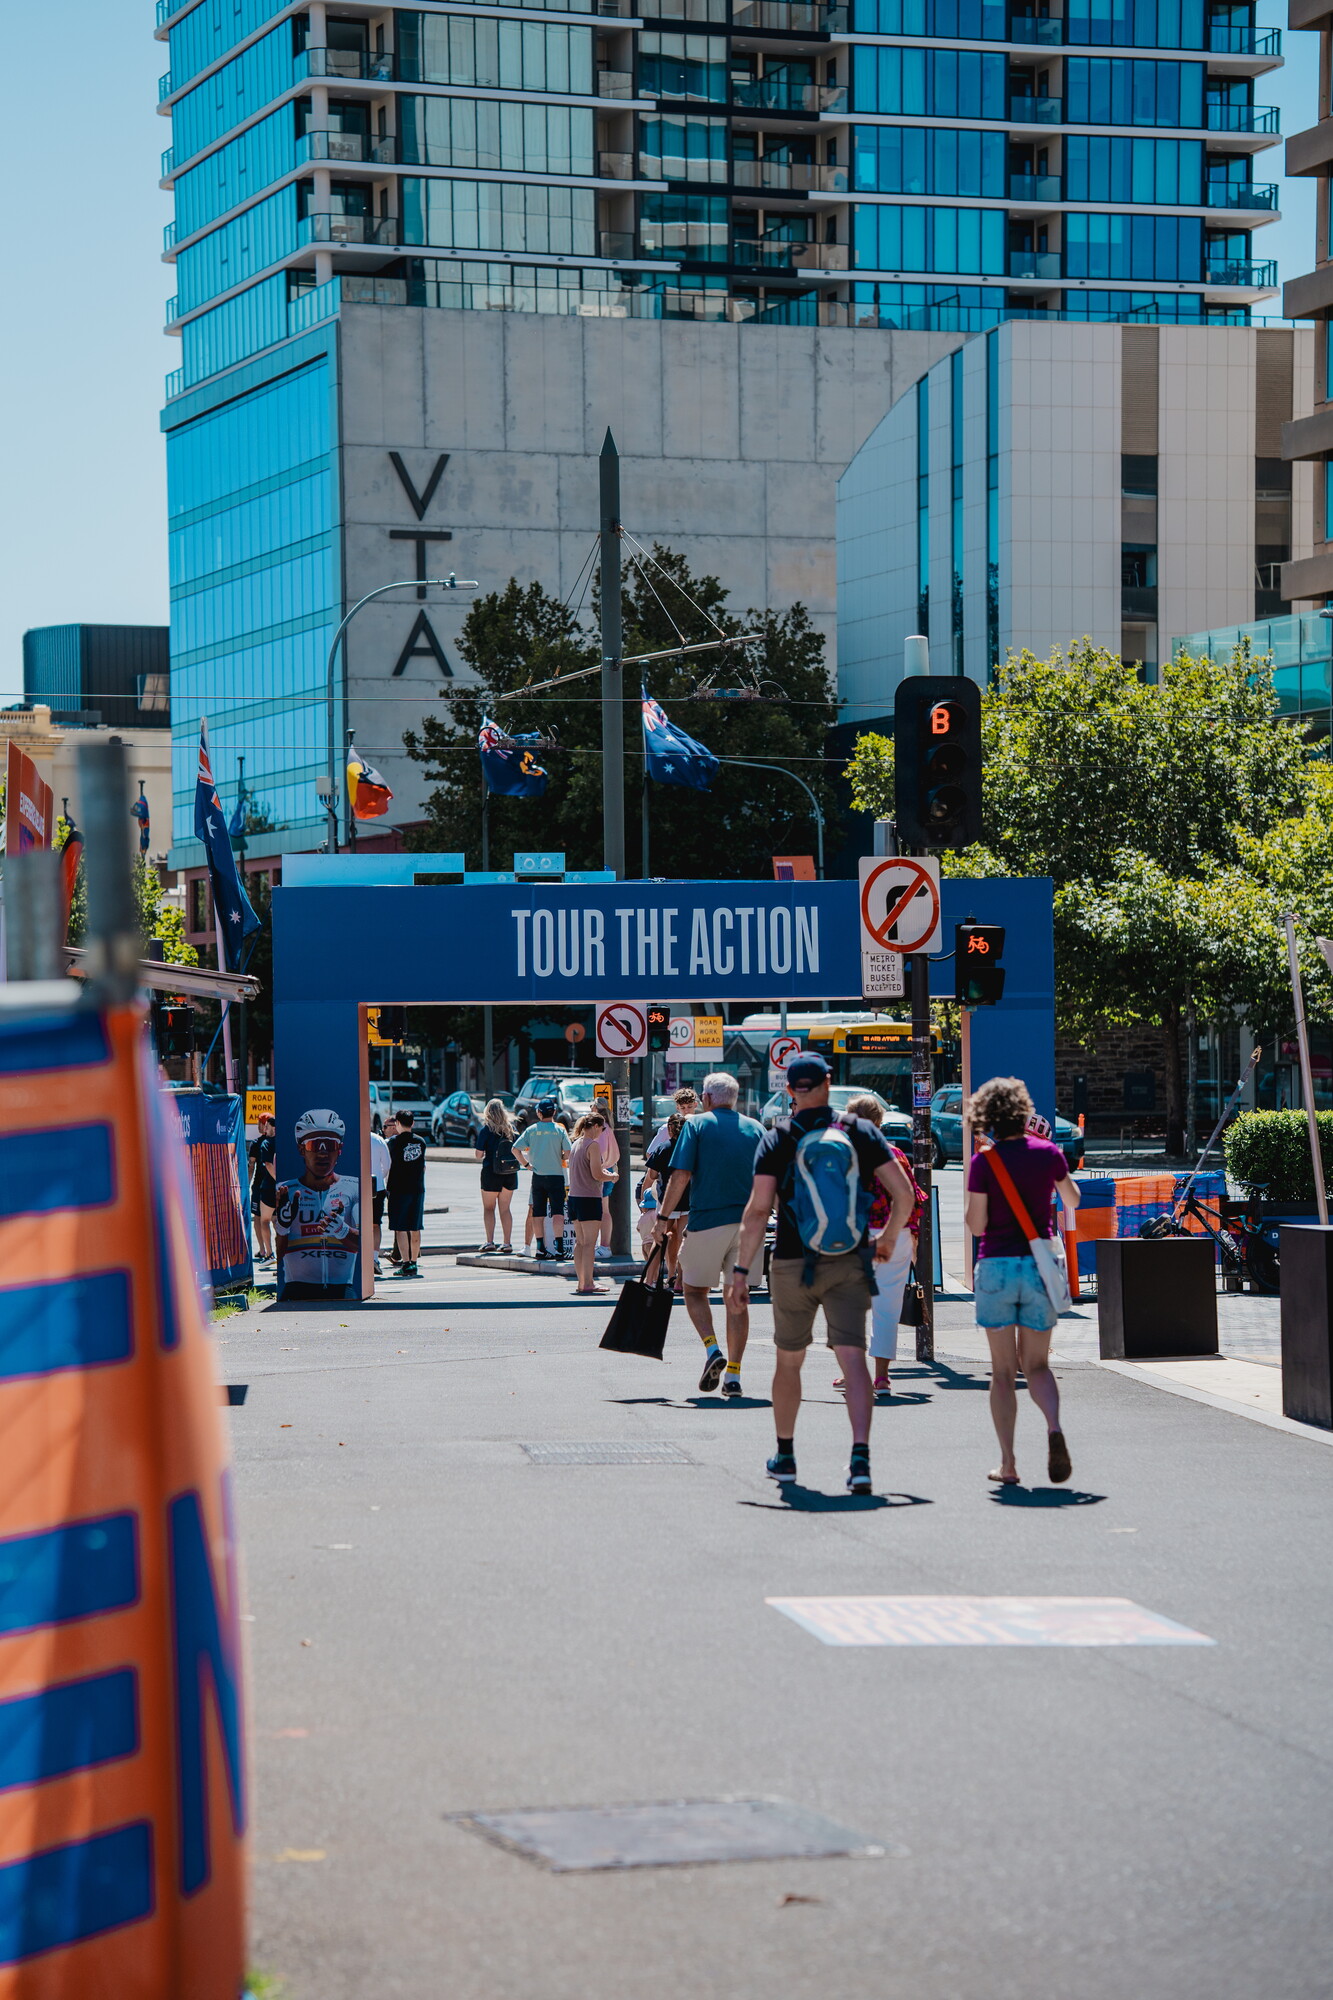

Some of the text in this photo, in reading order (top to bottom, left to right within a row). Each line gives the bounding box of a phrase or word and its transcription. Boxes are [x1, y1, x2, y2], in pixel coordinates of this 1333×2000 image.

[932, 707, 950, 734] B
[511, 906, 820, 977] TOUR THE ACTION
[870, 955, 896, 963] METRO
[870, 964, 896, 972] TICKET
[870, 974, 896, 982] BUSES
[866, 983, 902, 992] EXCEPTED
[670, 1026, 689, 1039] 40
[252, 1094, 273, 1102] ROAD
[301, 1250, 348, 1260] XRG
